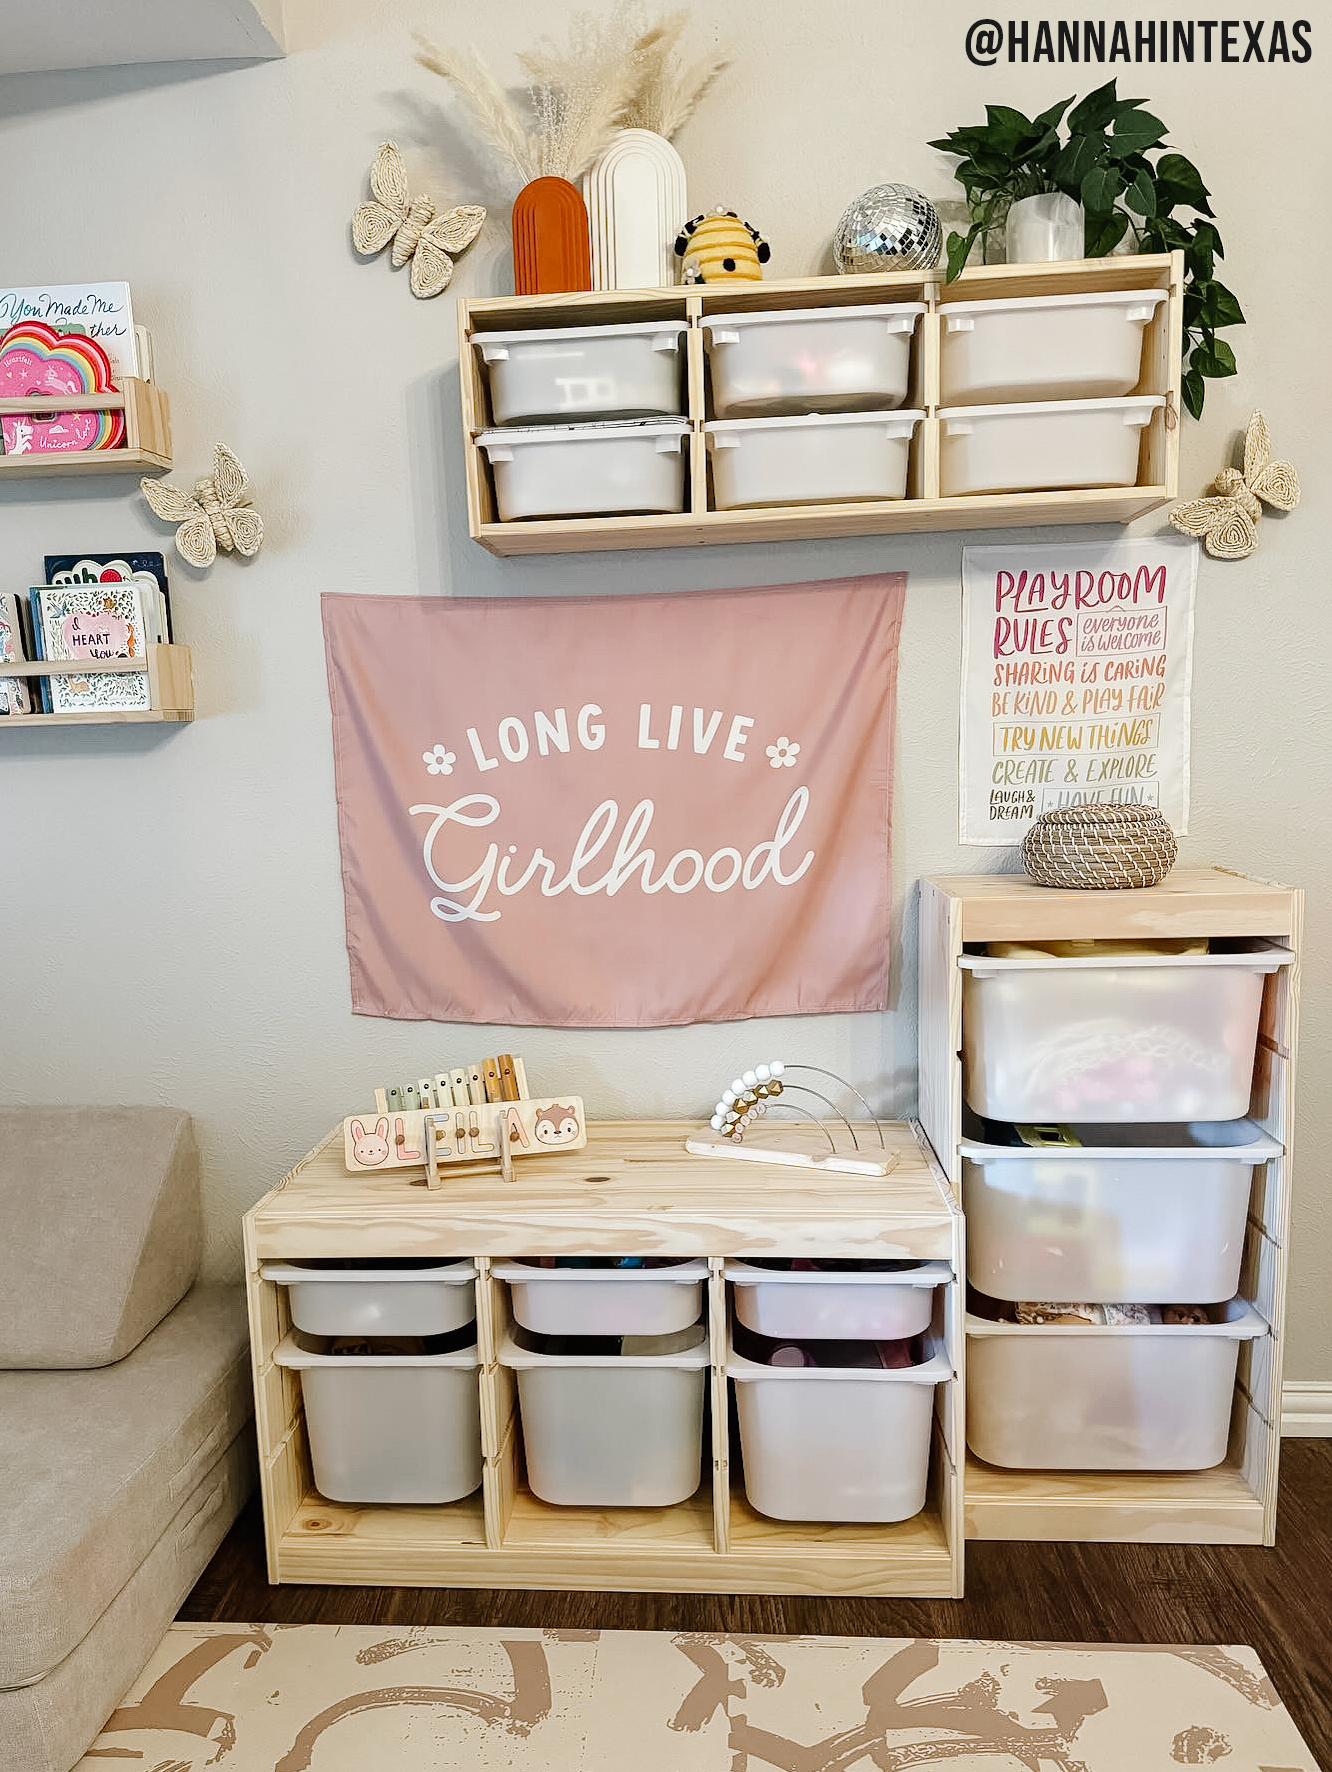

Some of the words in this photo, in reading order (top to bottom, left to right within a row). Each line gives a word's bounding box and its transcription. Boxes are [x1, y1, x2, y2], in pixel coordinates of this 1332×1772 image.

[39, 293, 89, 318] Made
[87, 294, 124, 315] Me
[89, 321, 127, 338] ther
[40, 437, 79, 449] Unicorn
[995, 565, 1167, 613] PLAYROOM
[1082, 613, 1159, 634] everyone
[72, 633, 110, 646] HEART
[993, 616, 1073, 659] RULES
[1081, 635, 1095, 651] is
[991, 691, 1011, 717] BE
[1061, 690, 1078, 716] &
[1082, 687, 1123, 714] PLAY
[466, 703, 606, 773] LONG
[638, 703, 757, 763] LIVE
[1000, 726, 1035, 753] TRY
[1039, 725, 1083, 752] NEW
[992, 758, 1058, 786] CREATE
[1063, 758, 1079, 783] &
[1086, 753, 1158, 783] EXPLORE
[989, 804, 1034, 821] DREAM
[409, 786, 815, 923] Girlhood
